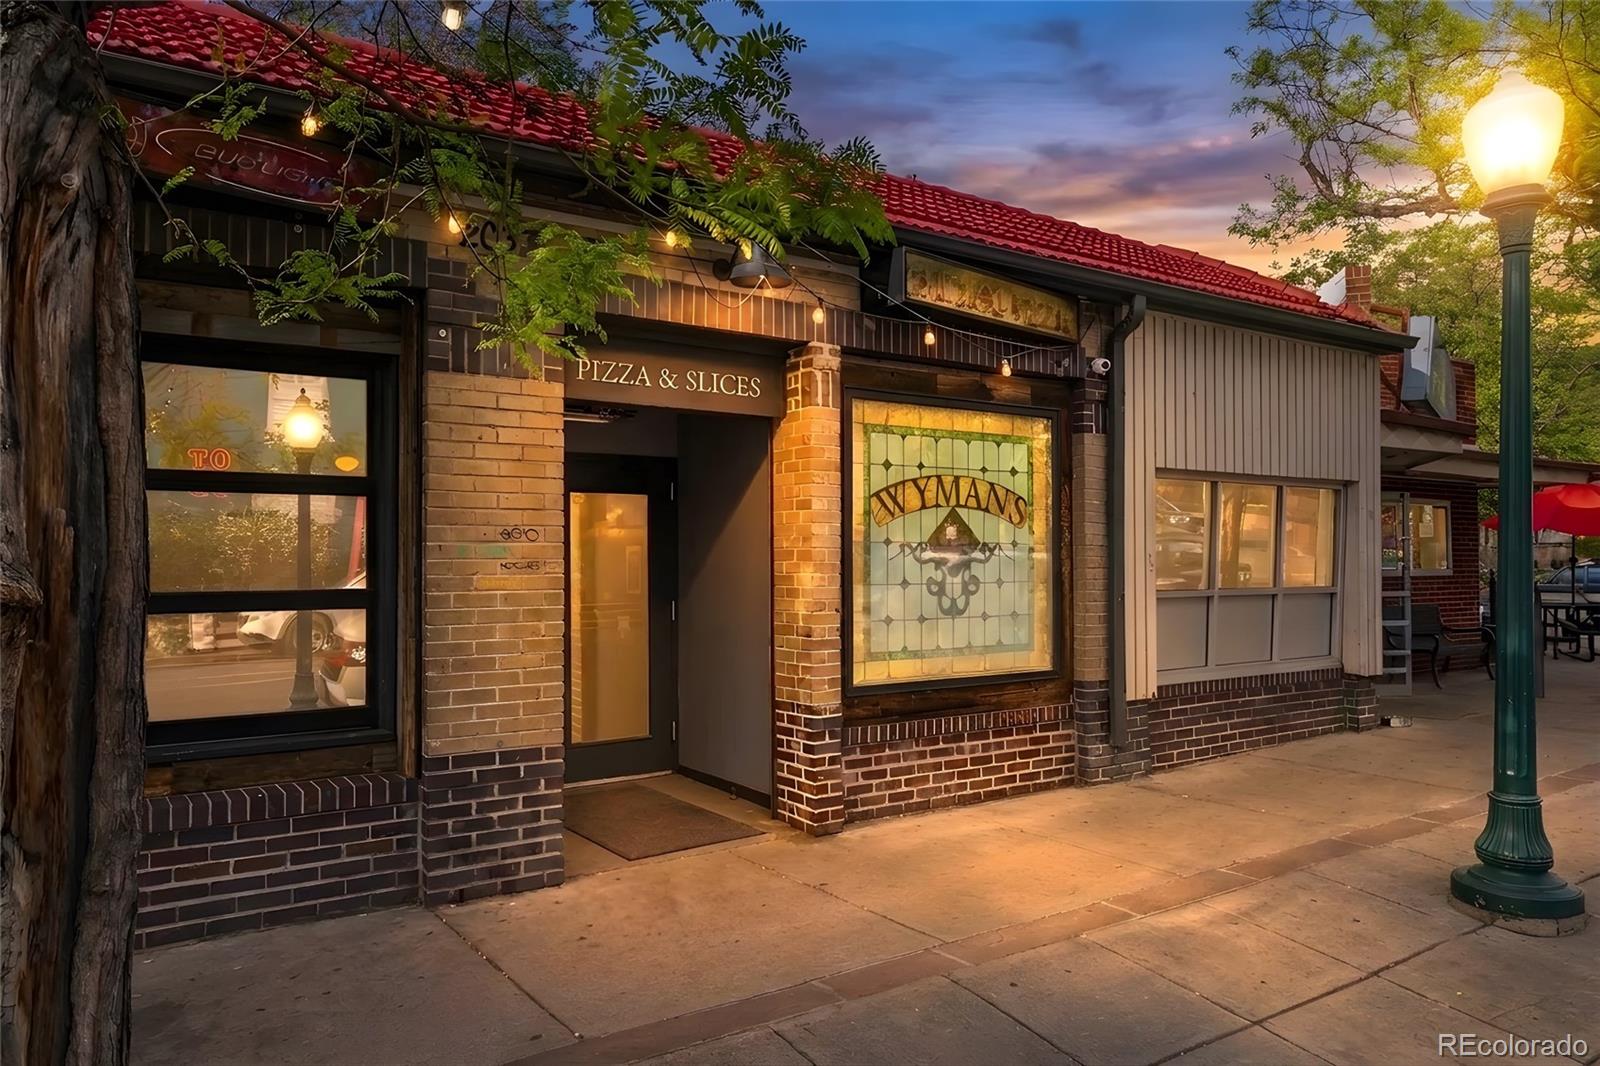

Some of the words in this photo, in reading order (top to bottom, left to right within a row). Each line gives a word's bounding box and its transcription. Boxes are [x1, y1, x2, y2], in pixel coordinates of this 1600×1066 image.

[576, 358, 652, 387] PIZZA
[659, 368, 679, 390] &
[686, 370, 761, 398] SLICES
